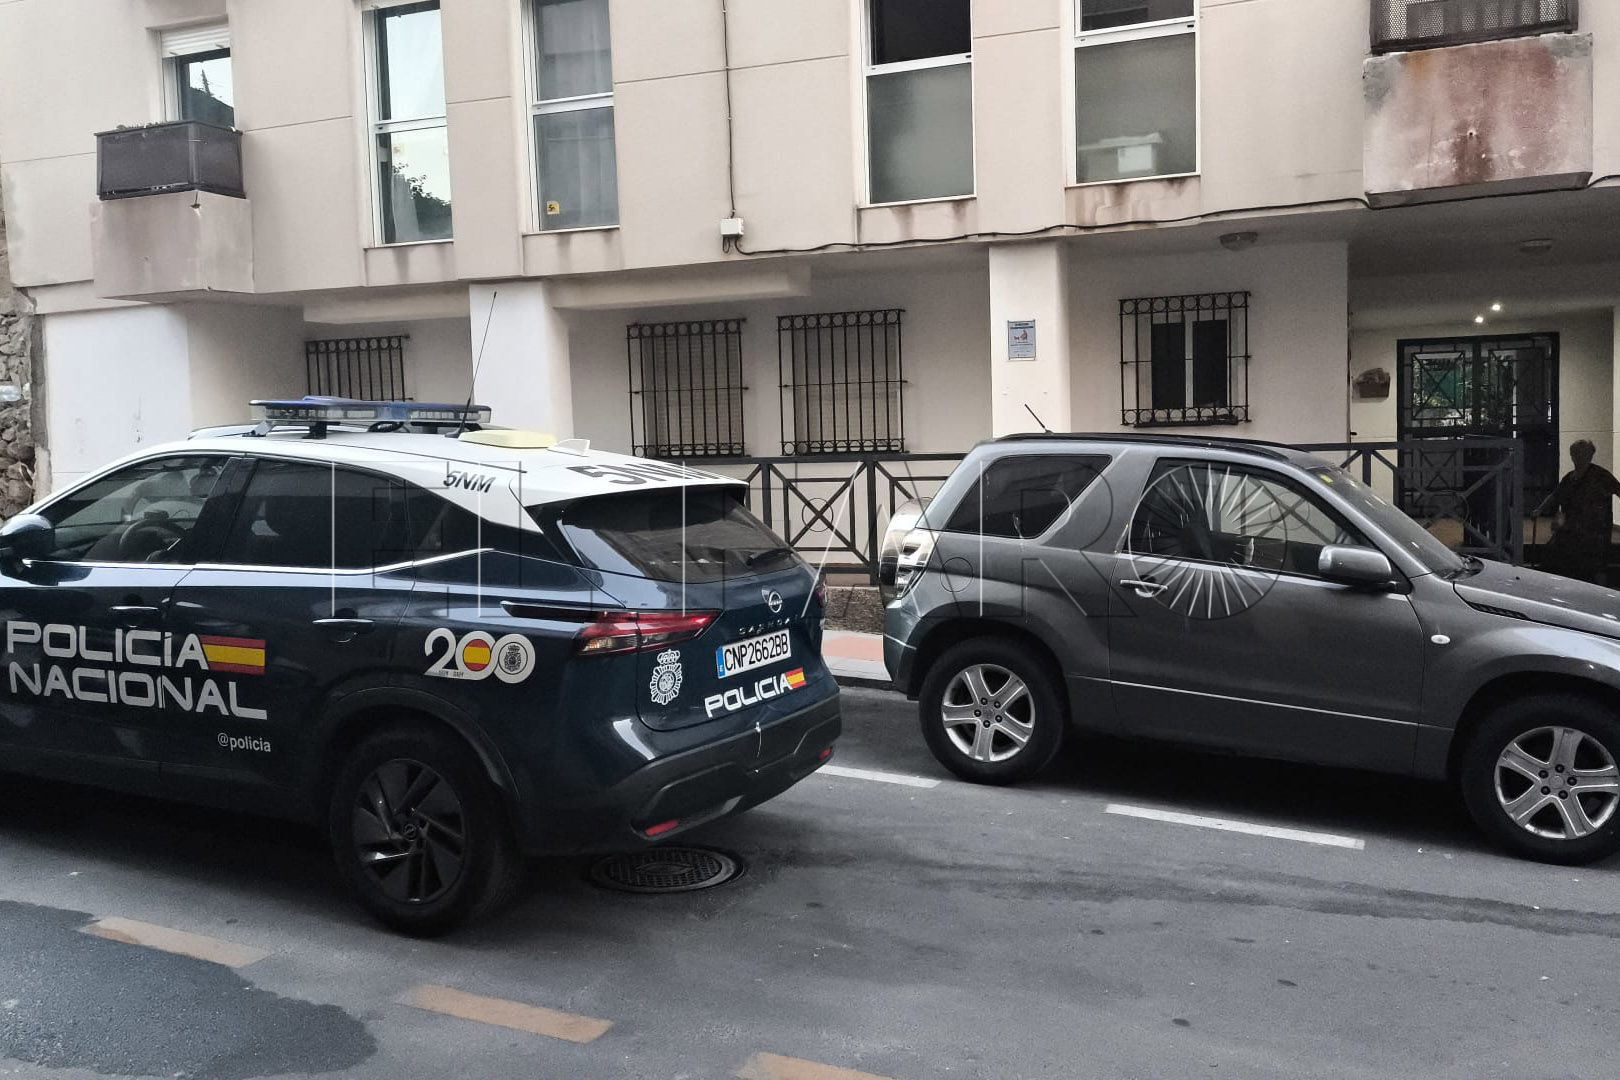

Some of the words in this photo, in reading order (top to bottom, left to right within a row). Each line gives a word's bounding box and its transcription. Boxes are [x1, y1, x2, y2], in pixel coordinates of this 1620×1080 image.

[443, 471, 496, 493] 5NM
[424, 627, 536, 684] 200
[724, 633, 788, 671] CNP2662BB
[8, 660, 268, 720] NACIONAL
[217, 732, 271, 752] @policia
